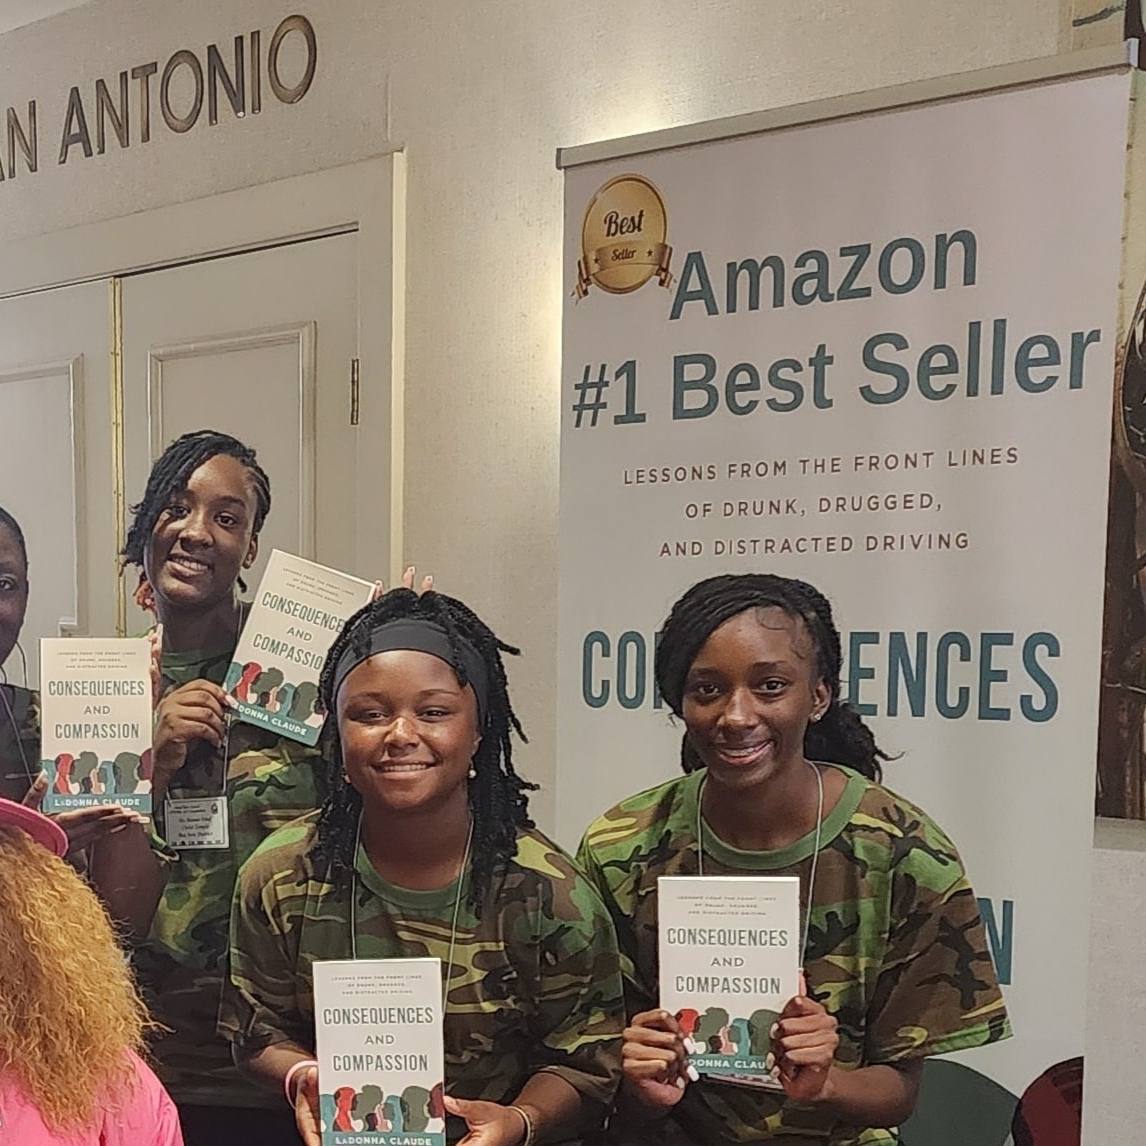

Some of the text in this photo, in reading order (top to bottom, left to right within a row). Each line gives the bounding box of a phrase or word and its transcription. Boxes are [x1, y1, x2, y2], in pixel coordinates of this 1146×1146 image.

[58, 14, 318, 165] ANTONIO
[604, 209, 645, 237] Best
[611, 248, 636, 261] Seller
[669, 227, 976, 320] Amazon
[572, 319, 1101, 428] #1 Best Seller
[624, 447, 1019, 485] LESSONS FROM THE FRONT LINES
[685, 493, 943, 519] OF DRUNK, DRUGGED,
[659, 532, 970, 558] AND DISTRACTED DRIVING
[261, 592, 346, 633] CONSEQUENCE
[286, 627, 312, 642] AND
[253, 633, 324, 670] COMPASSIO
[582, 629, 1061, 723] COENCES
[48, 680, 145, 696] CONSEQUENCES
[84, 705, 111, 715] AND
[238, 705, 269, 722] DONNA
[55, 723, 139, 739] COMPASSION
[667, 928, 788, 947] CONSEQUENCES
[711, 957, 744, 967] AND
[676, 976, 781, 994] COMPASSION
[323, 1007, 433, 1025] CONSEQUENCES
[365, 1034, 395, 1045] AND
[333, 1055, 428, 1071] COMPASSION
[735, 1060, 766, 1069] CLAU
[390, 1137, 432, 1146] CLAUDE
